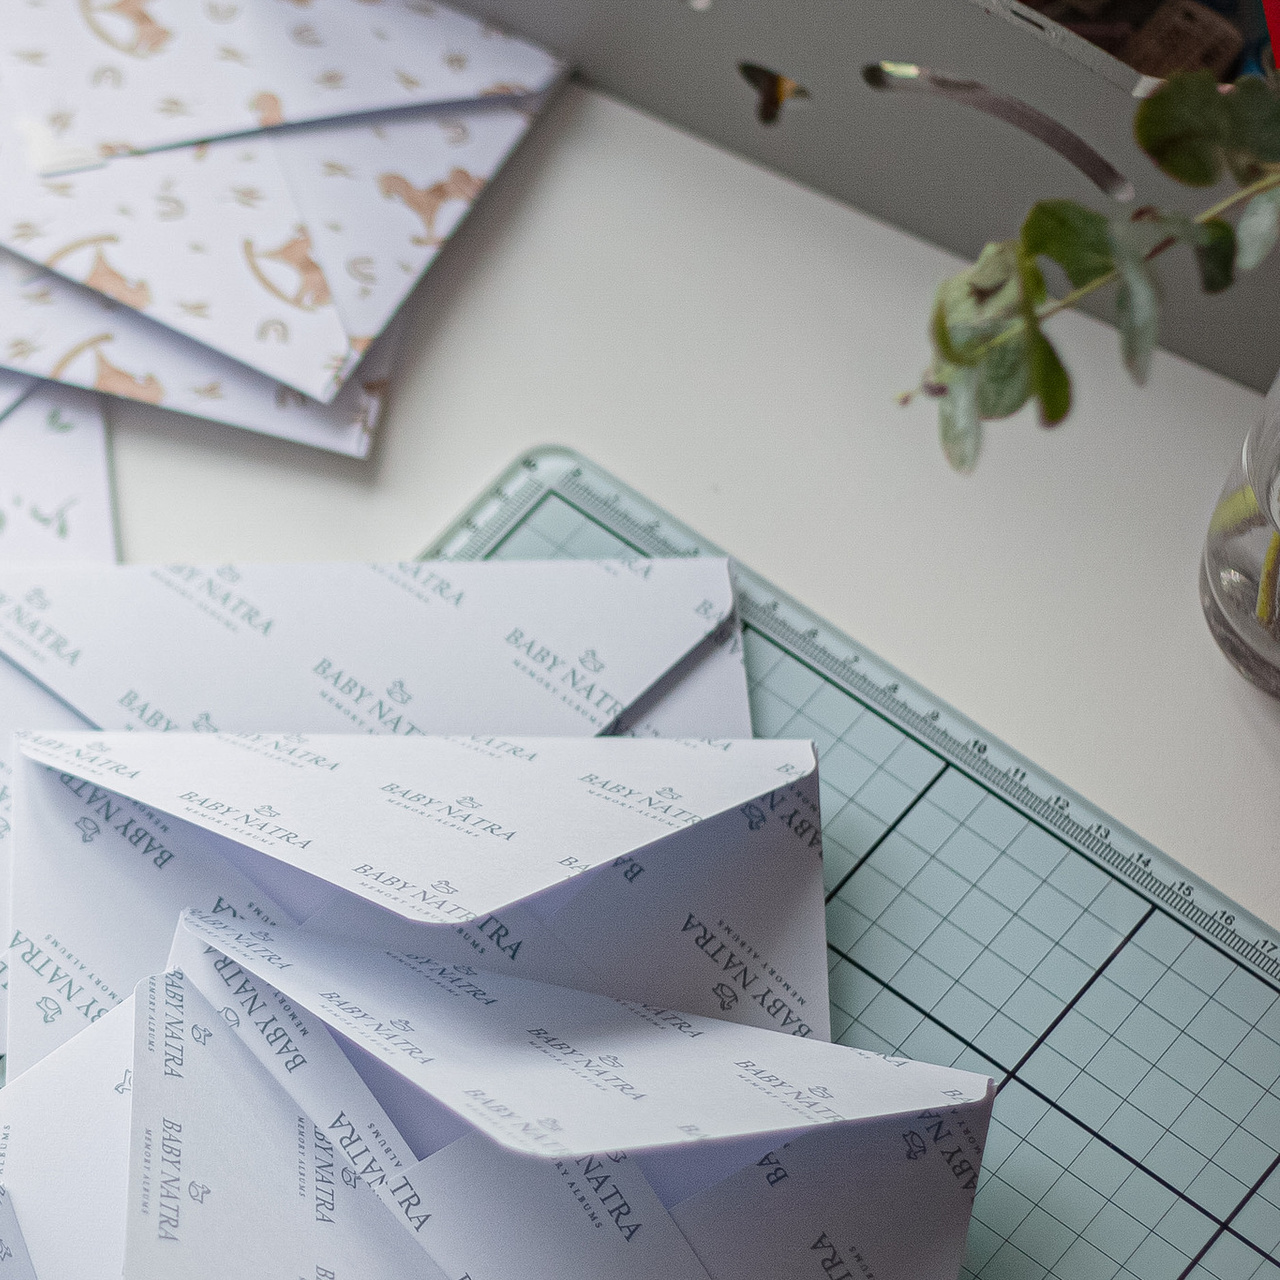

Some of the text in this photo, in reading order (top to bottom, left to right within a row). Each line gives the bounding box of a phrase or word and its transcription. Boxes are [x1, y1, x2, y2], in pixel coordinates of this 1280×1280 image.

[13, 602, 83, 667] NATRA
[313, 657, 428, 736] BABY NAT
[505, 626, 626, 718] BABY NATR
[117, 689, 180, 732] BABY
[60, 770, 175, 870] BABY NATR
[177, 791, 313, 850] BABY NATRA
[379, 782, 518, 842] BABY NATRA
[578, 772, 704, 825] BABY NATR
[351, 863, 480, 924] BABY NATR
[1134, 851, 1153, 868] 14
[1176, 880, 1195, 898] 15
[1218, 909, 1236, 927] 16
[1260, 937, 1279, 955] 17
[8, 929, 85, 1002] NATRA
[226, 933, 293, 970] NATRA
[680, 912, 813, 1037] BABY NATRA
[429, 967, 498, 1006] NATRA
[163, 966, 185, 1079] BABY NATRA
[254, 1014, 308, 1074] BABY
[318, 990, 435, 1065] BABY NATRA
[526, 1027, 648, 1101] BABY NATRA
[733, 1059, 847, 1122] BABY NATR
[367, 1122, 403, 1169] ALBUMS
[158, 1117, 183, 1242] BABY NATRA
[314, 1154, 336, 1224] NATRA
[566, 1179, 603, 1230] ALBUMS
[575, 1154, 644, 1243] NATRA
